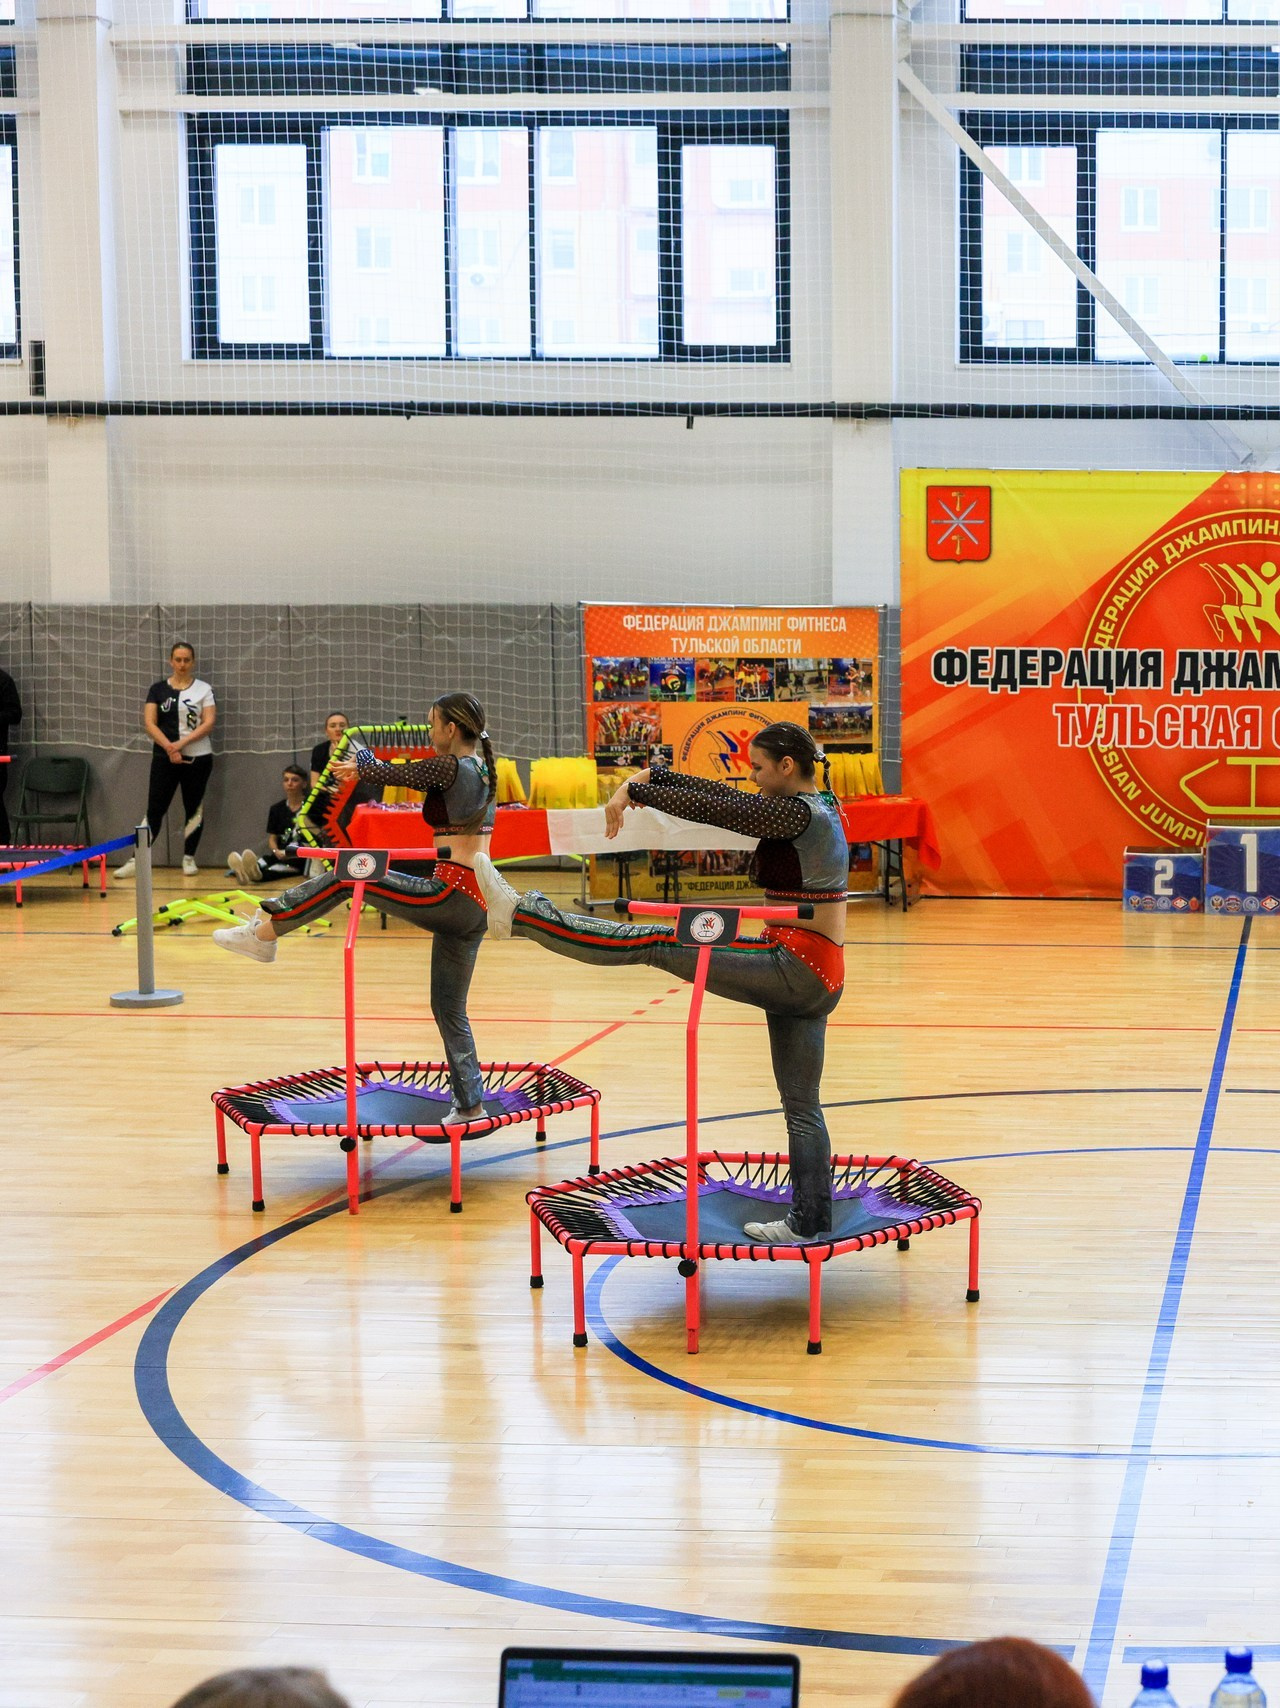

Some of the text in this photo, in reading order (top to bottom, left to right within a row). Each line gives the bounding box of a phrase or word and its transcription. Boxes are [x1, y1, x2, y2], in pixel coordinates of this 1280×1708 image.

[622, 614, 847, 632] ФЕДЕРАЦИЯ ДЖАМПИНГ ФИТНЕСА
[1093, 557, 1160, 650] ДЕРАЦИЯ
[671, 635, 802, 654] ТУЛЬСКОЙ ОБЛАСТИ
[931, 646, 1164, 695] ФЕДЕРАЦИЯ
[705, 709, 748, 725] ДЖАМПИНГ
[1053, 703, 1262, 750] ТУЛЬСКАЯ
[1139, 802, 1207, 848] JUMPI
[1154, 858, 1174, 896] 2
[1240, 833, 1258, 893] 1
[801, 892, 829, 900] GUCCI
